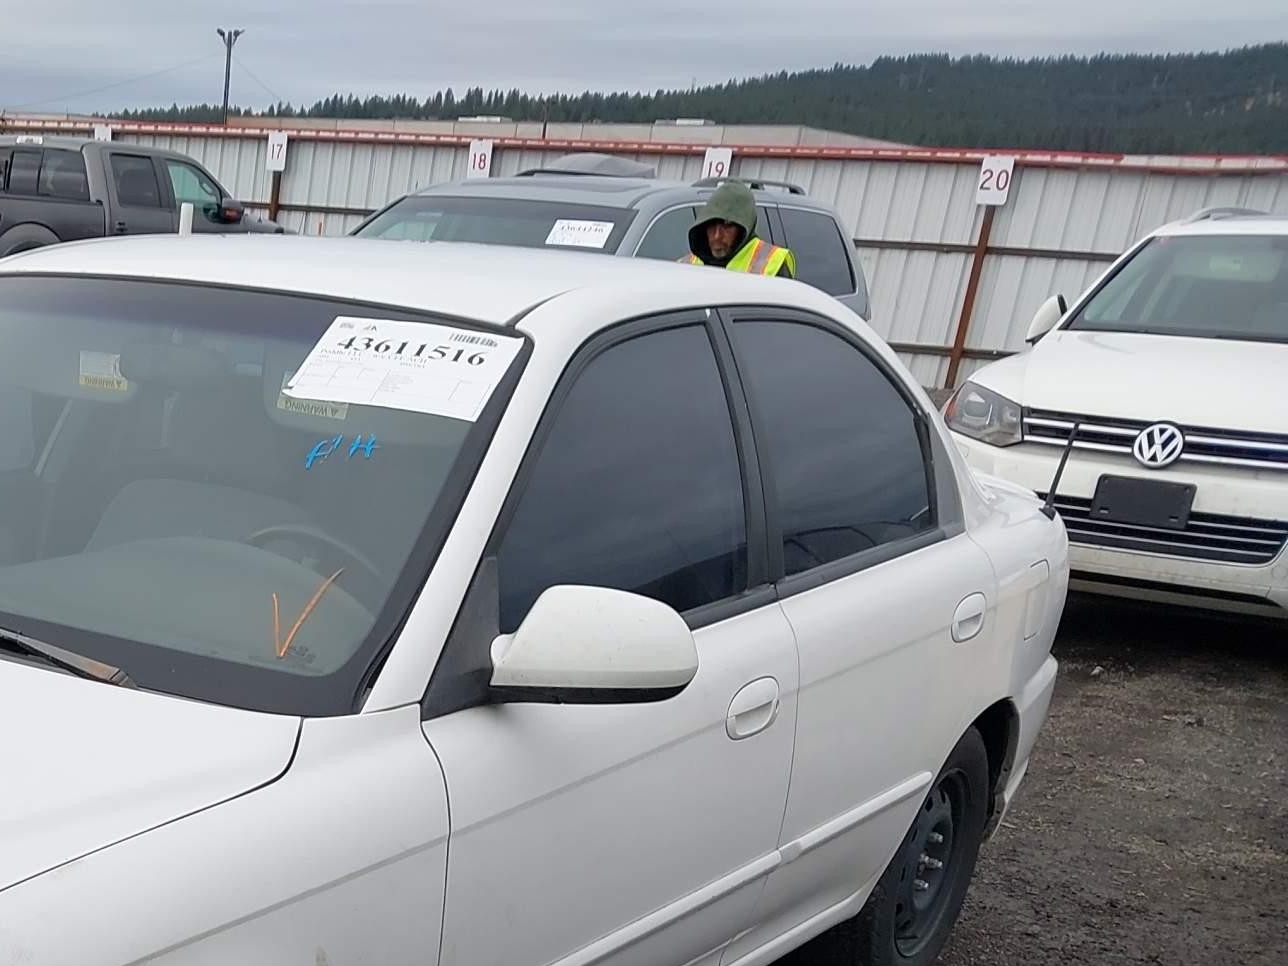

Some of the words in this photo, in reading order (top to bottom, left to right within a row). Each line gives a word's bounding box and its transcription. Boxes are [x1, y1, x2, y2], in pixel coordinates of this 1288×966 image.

[271, 143, 283, 160] 17
[472, 152, 487, 170] 18
[707, 161, 725, 177] 19
[979, 168, 1010, 191] 20
[336, 335, 489, 366] 43611516
